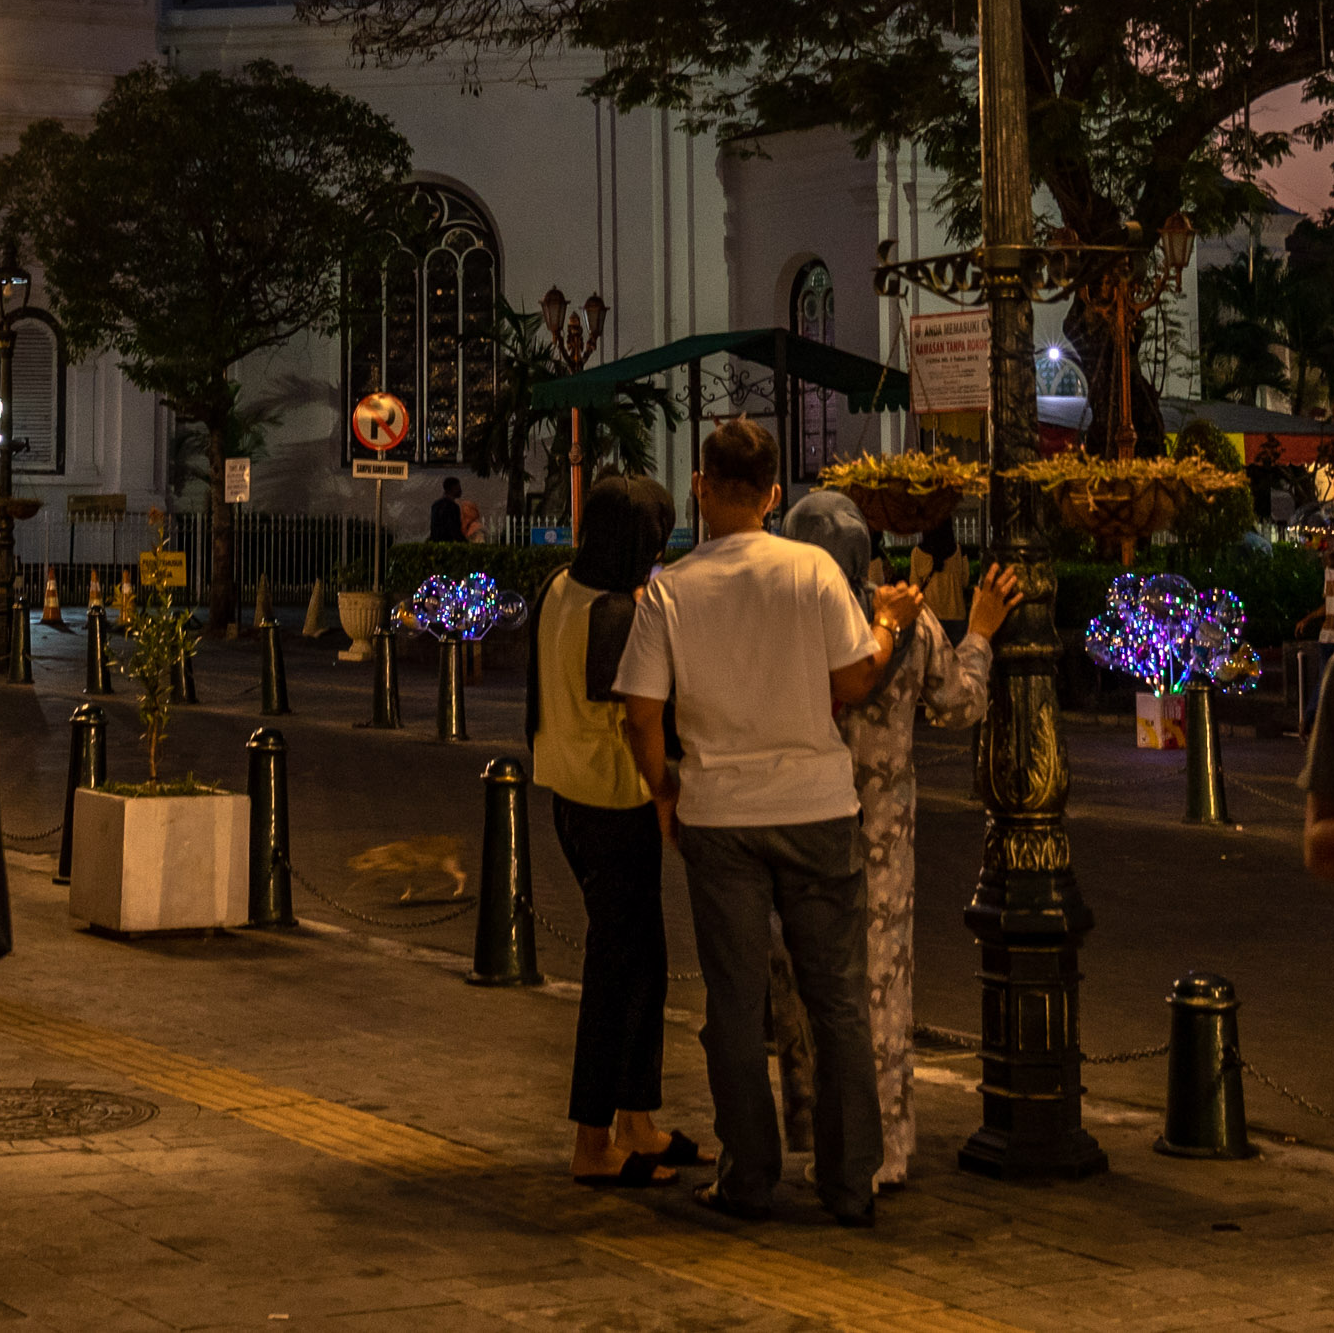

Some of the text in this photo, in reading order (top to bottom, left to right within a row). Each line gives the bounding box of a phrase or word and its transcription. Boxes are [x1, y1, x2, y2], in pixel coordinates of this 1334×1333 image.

[924, 319, 980, 337] ANDA MEMASUKI
[916, 341, 945, 355] KAWASAN
[946, 339, 966, 353] TANPA
